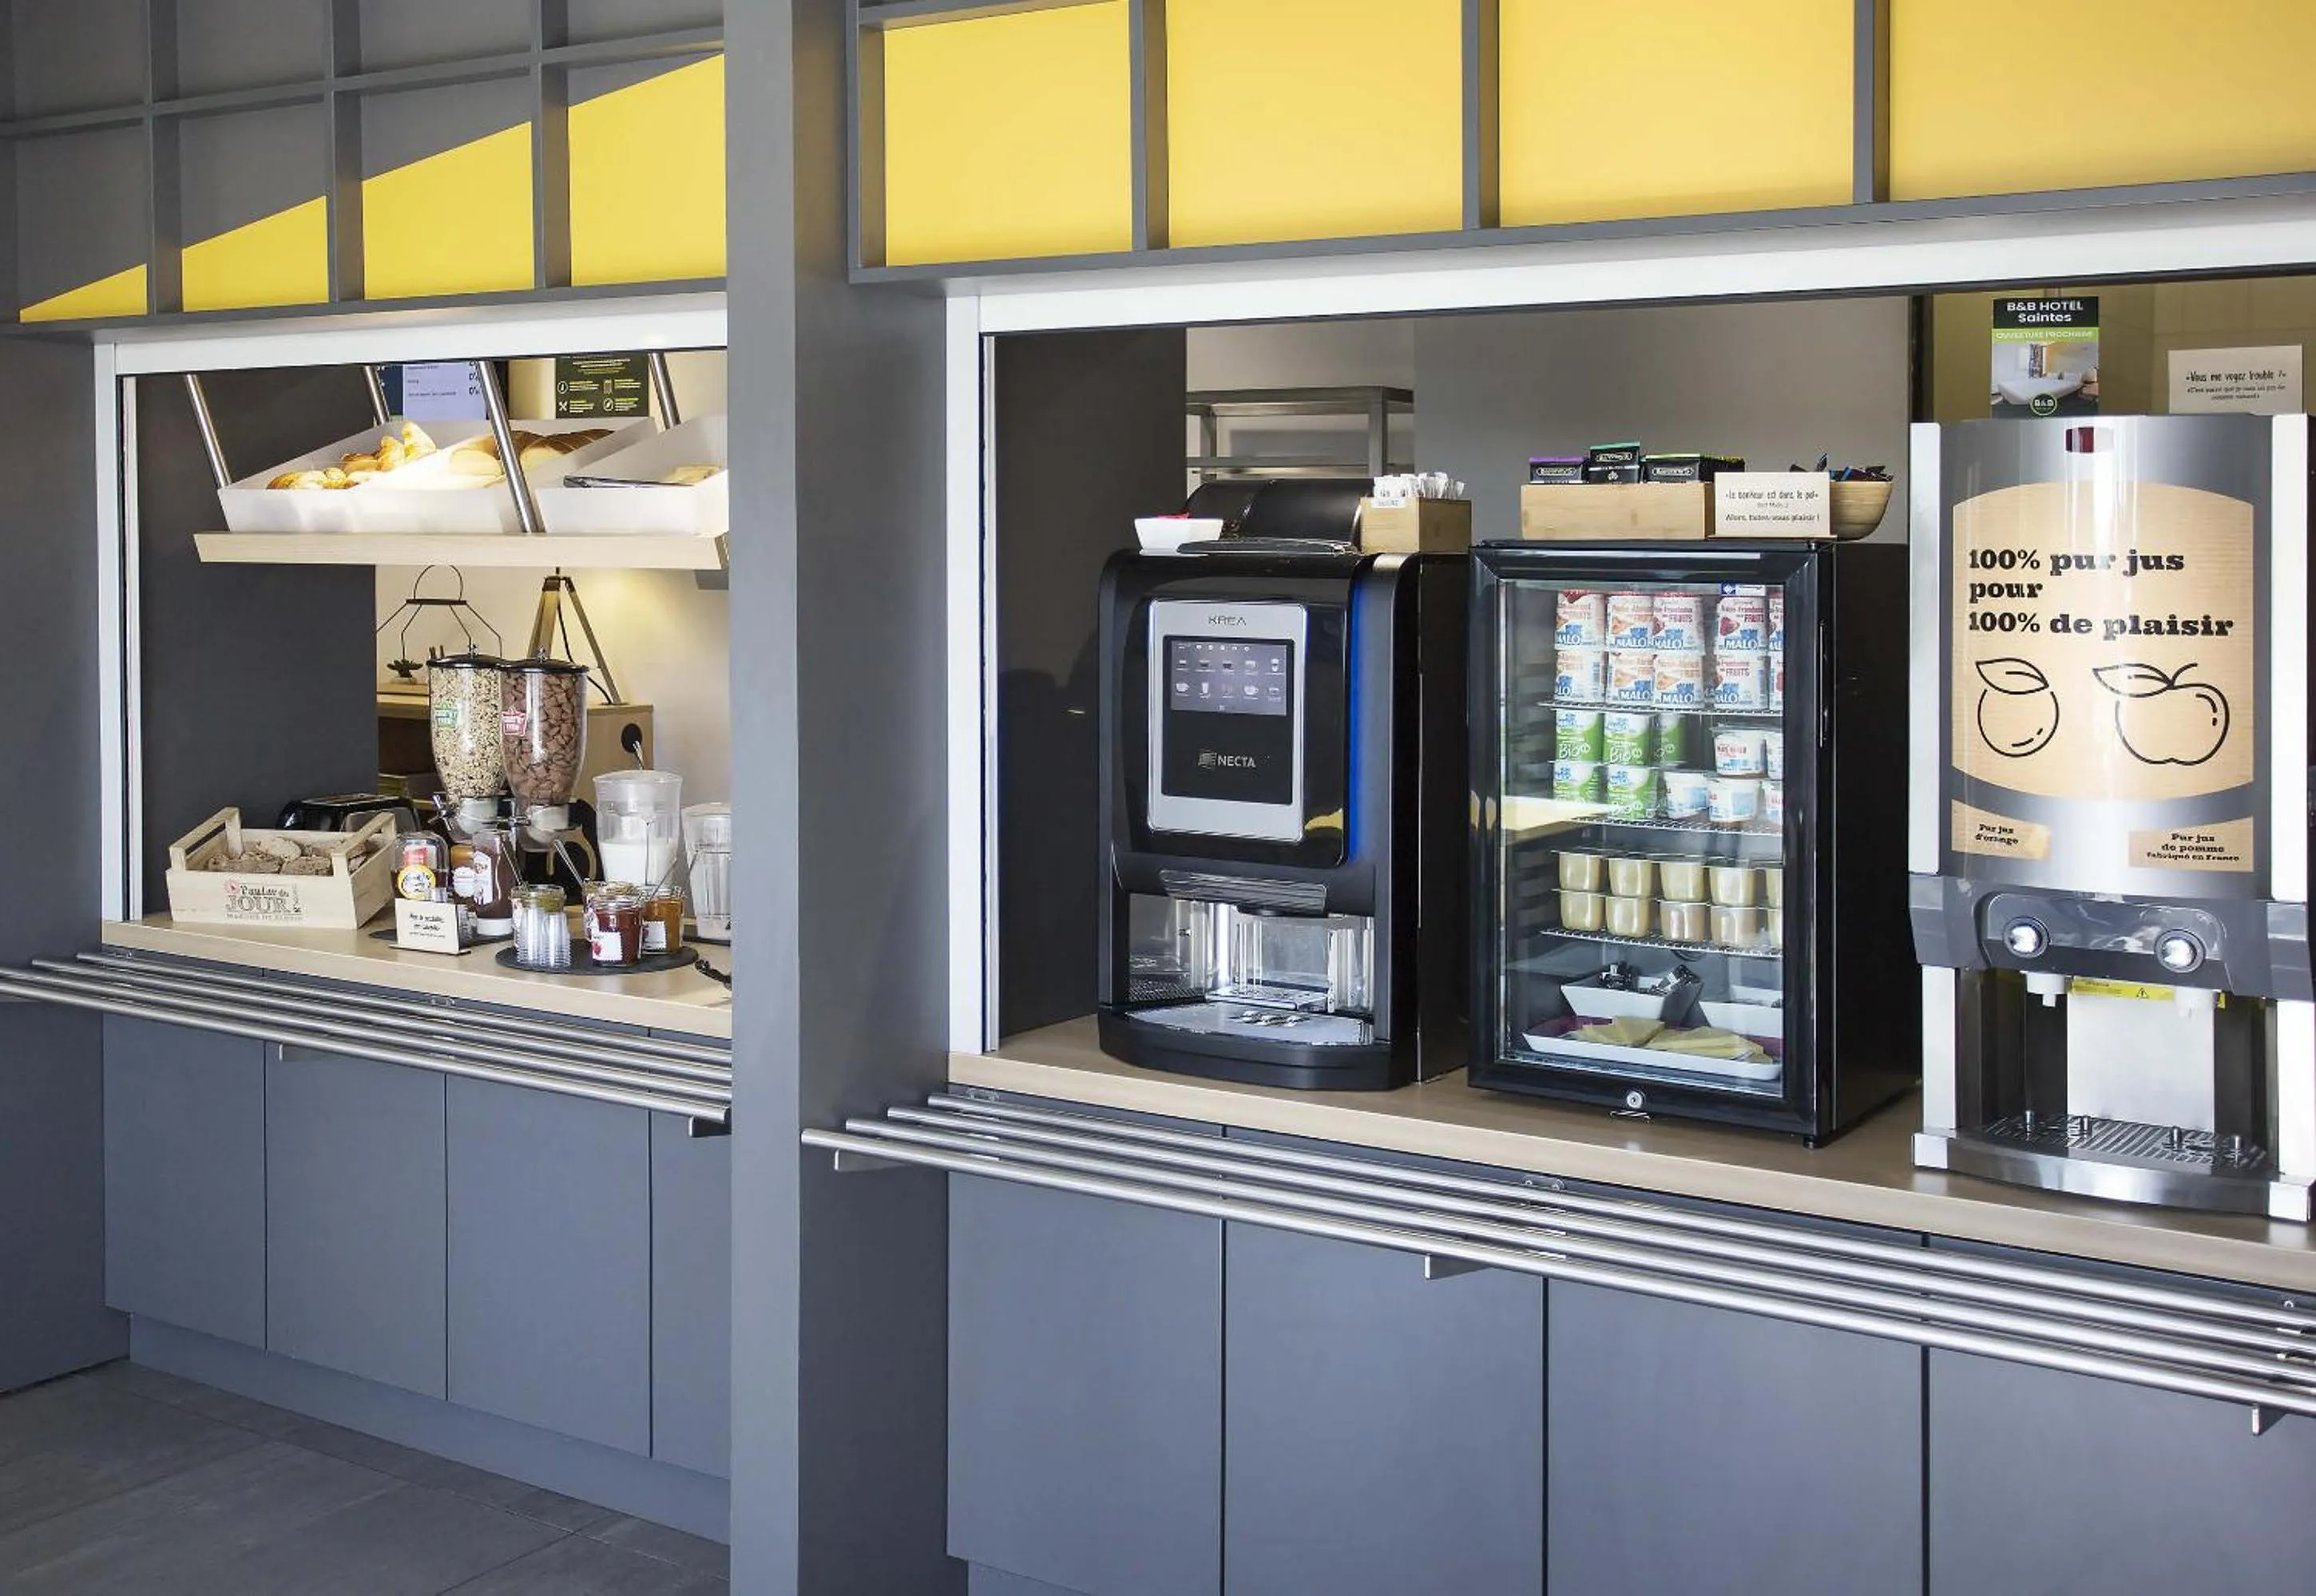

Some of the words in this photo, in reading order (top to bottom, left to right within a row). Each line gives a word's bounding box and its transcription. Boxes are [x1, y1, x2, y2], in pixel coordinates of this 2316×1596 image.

[2006, 302, 2036, 311] B&B
[2039, 300, 2084, 311] HOTEL
[2017, 312, 2072, 323] Saintes
[2210, 373, 2222, 382] me
[1969, 549, 2040, 570] 100%
[2049, 552, 2116, 576] pur
[2123, 549, 2185, 576] jus
[1969, 582, 2043, 604] pour
[1208, 615, 1247, 626] KREA
[1969, 612, 2040, 632] 100%
[2049, 614, 2093, 634] de
[2104, 614, 2235, 641] plaisir
[1725, 639, 1758, 650] MALO
[1661, 692, 1694, 703] MALO
[1217, 755, 1256, 768] NECTA
[1979, 823, 1997, 832] Pur
[1997, 826, 2014, 834] jus
[1975, 833, 2019, 846] d'orange
[2195, 834, 2215, 843] jus
[225, 894, 291, 913] JOUR
